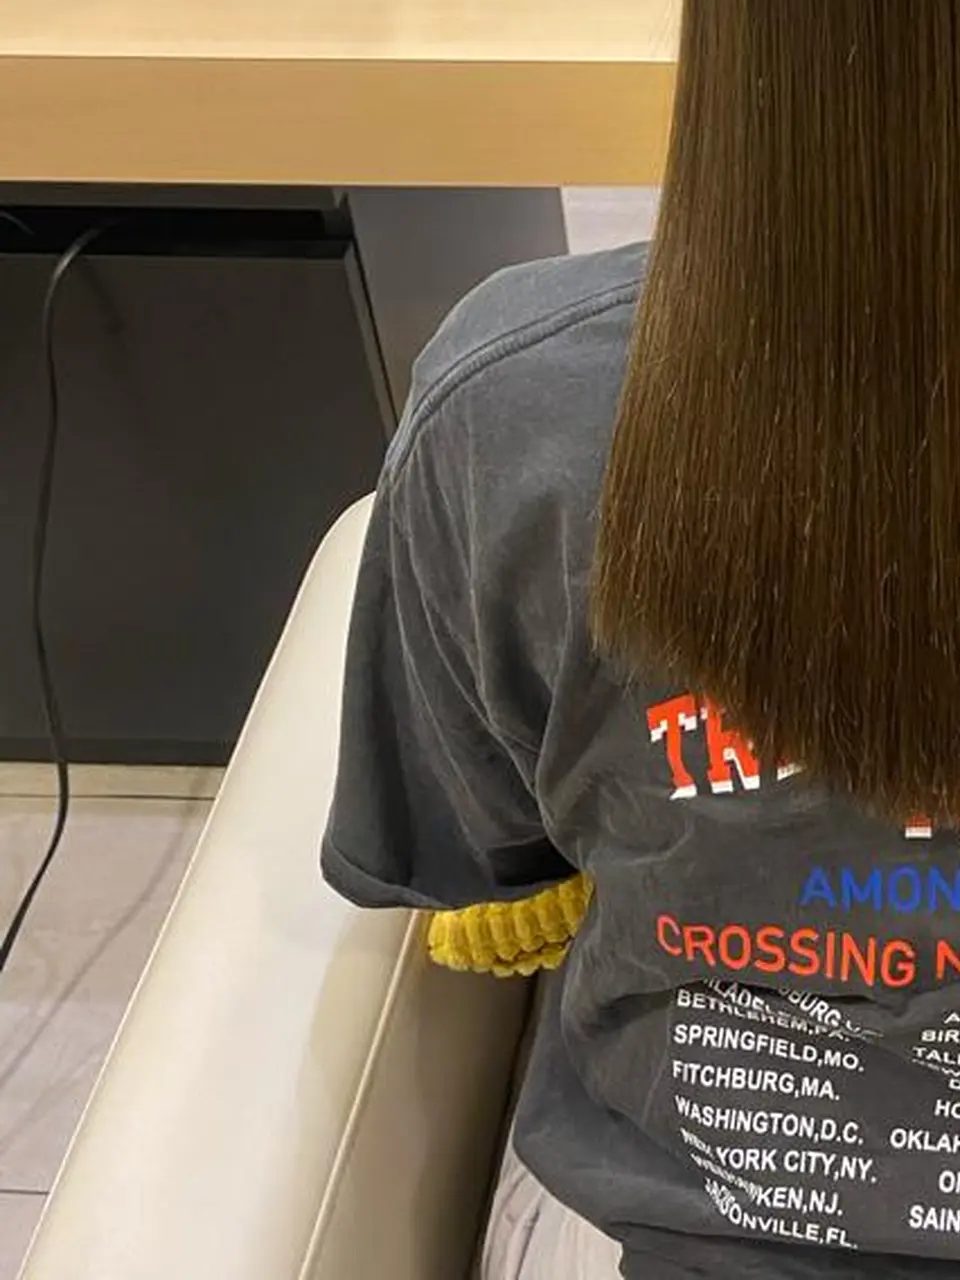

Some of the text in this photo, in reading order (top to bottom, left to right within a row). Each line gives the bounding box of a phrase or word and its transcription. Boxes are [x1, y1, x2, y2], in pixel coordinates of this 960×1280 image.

[656, 914, 916, 986] CROSSING
[673, 1023, 865, 1072] SPRINGFIELD,MO.
[672, 1060, 841, 1101] FITCHBURG,MA.
[675, 1094, 865, 1145] WASHINGTON,D.C.
[716, 1146, 777, 1171] YORK
[783, 1150, 878, 1184] CITY,NY.
